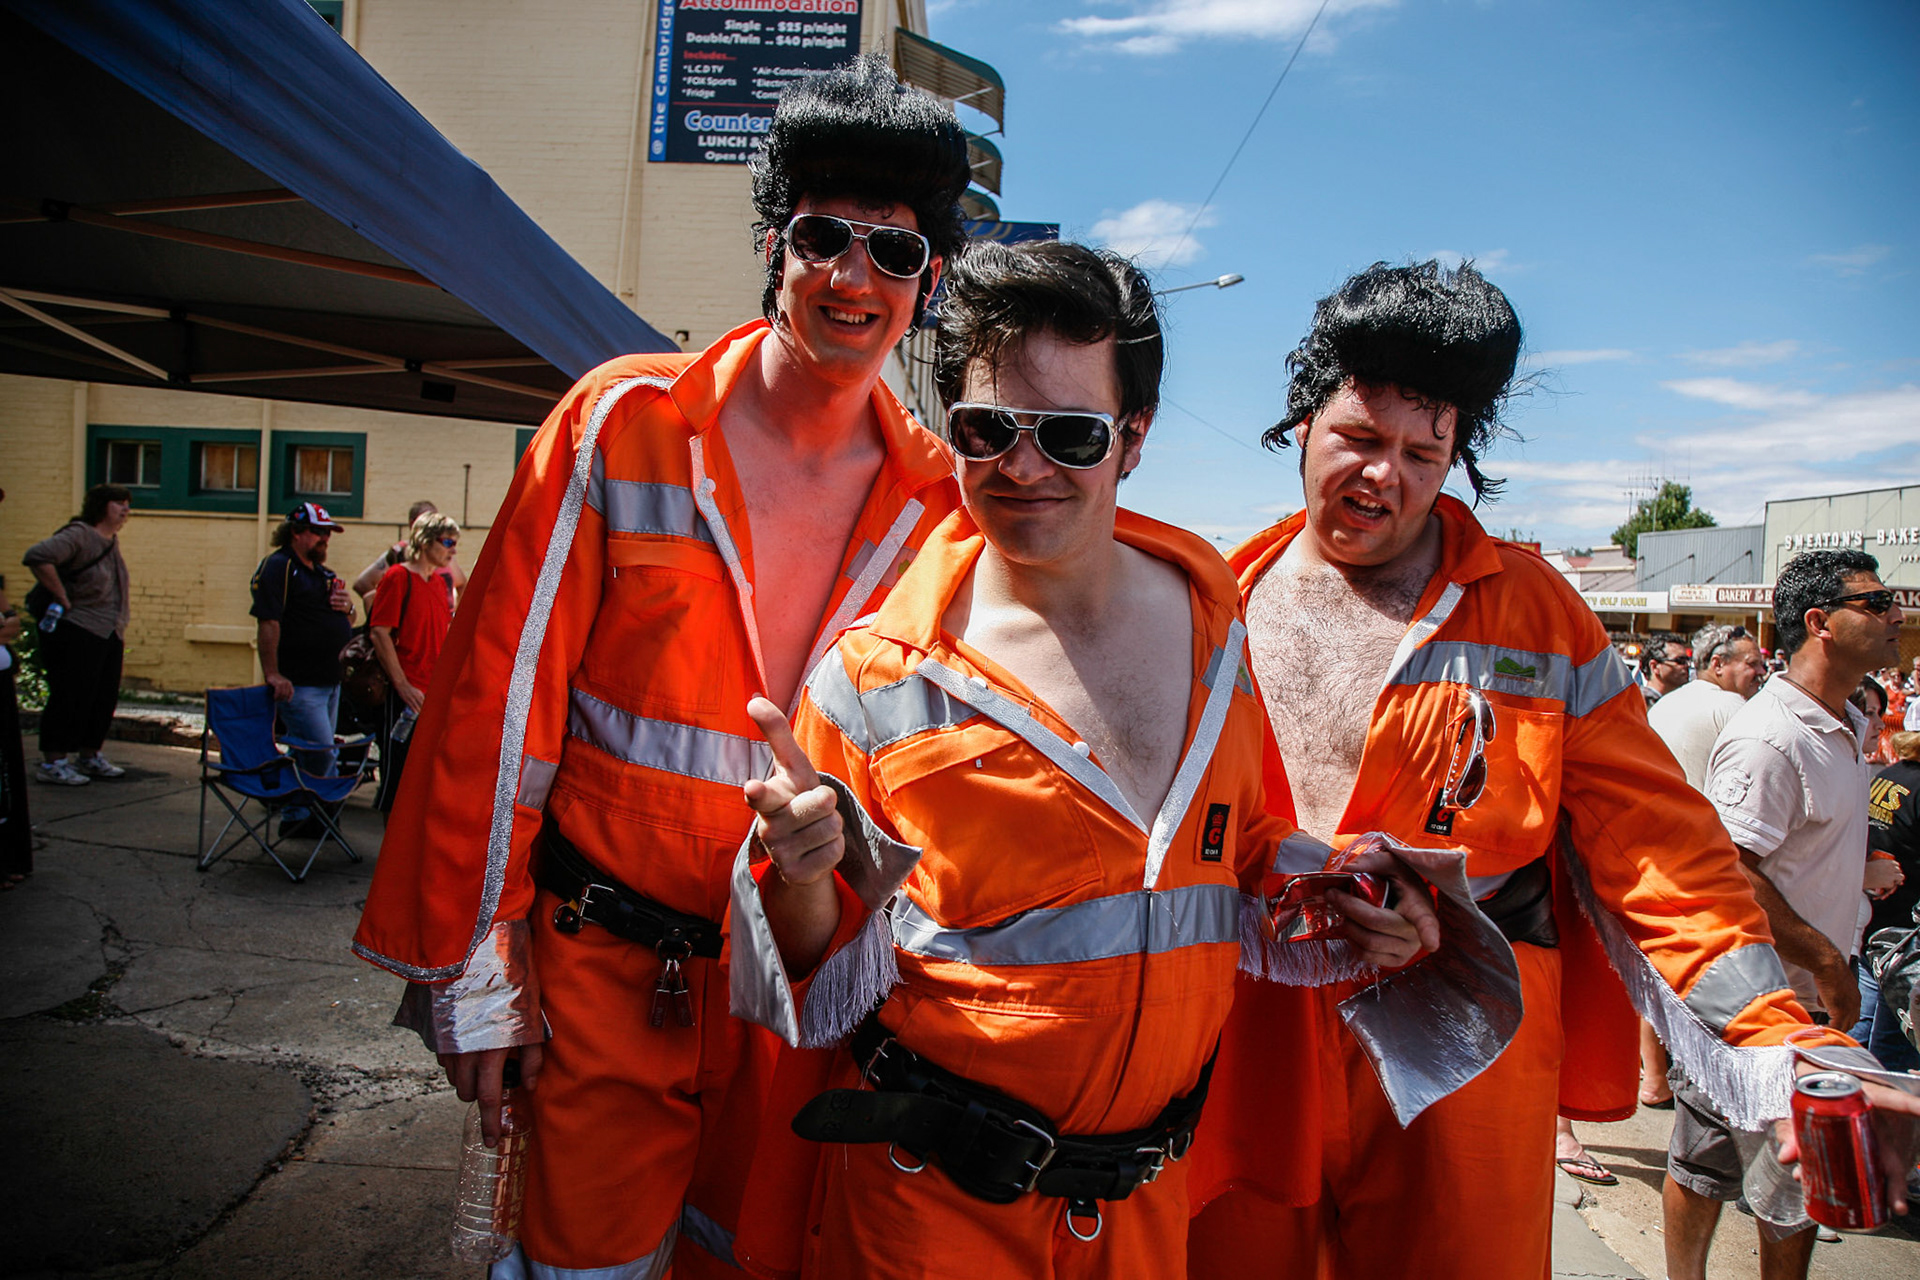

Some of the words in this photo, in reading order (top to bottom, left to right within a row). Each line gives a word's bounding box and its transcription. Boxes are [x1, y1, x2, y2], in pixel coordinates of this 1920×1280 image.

[679, 0, 859, 14] Accommodation
[724, 19, 761, 33] Single
[777, 21, 802, 33] $25
[802, 22, 848, 35] p/night
[686, 32, 761, 45] Double/Twin
[775, 35, 801, 46] $40
[801, 36, 847, 49] p/night
[711, 65, 724, 74] TV
[686, 76, 707, 86] FOX
[707, 76, 737, 87] Sports
[686, 88, 716, 99] Fridge
[653, 102, 666, 134] the
[684, 110, 773, 133] Counter
[698, 135, 748, 148] LUNCH
[704, 151, 737, 161] Open
[1784, 530, 1863, 550] SMEATON'S
[1718, 588, 1752, 602] BAKERY
